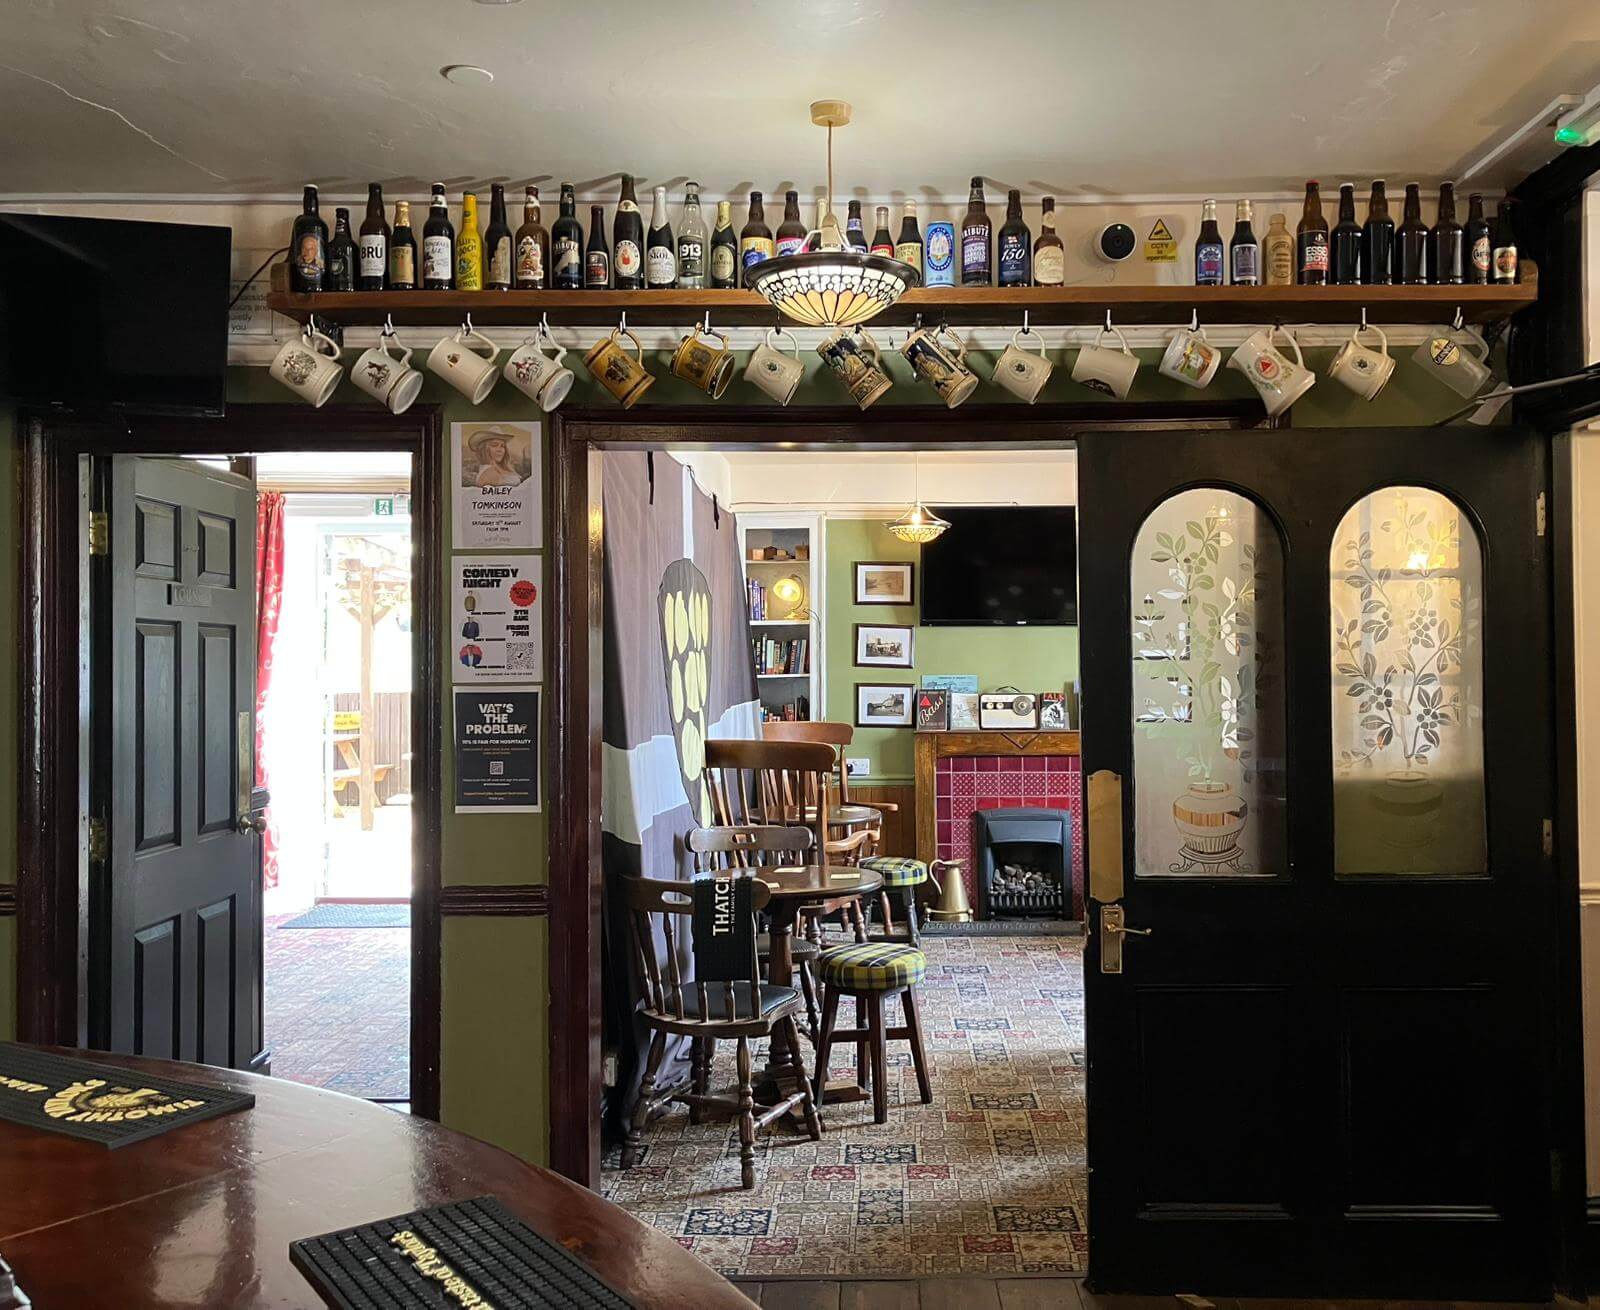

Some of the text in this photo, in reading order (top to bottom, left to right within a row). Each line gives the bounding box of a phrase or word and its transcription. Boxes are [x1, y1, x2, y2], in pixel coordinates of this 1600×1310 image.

[1001, 248, 1025, 261] 150
[482, 487, 512, 495] BAILEY
[472, 501, 522, 509] TOMKINSON
[463, 568, 519, 578] COMEDY
[463, 579, 502, 588] NIGHT
[478, 703, 514, 714] VAT'S
[919, 695, 944, 726] Bass
[484, 713, 509, 723] THE
[66, 1098, 205, 1123] TIMOTHY
